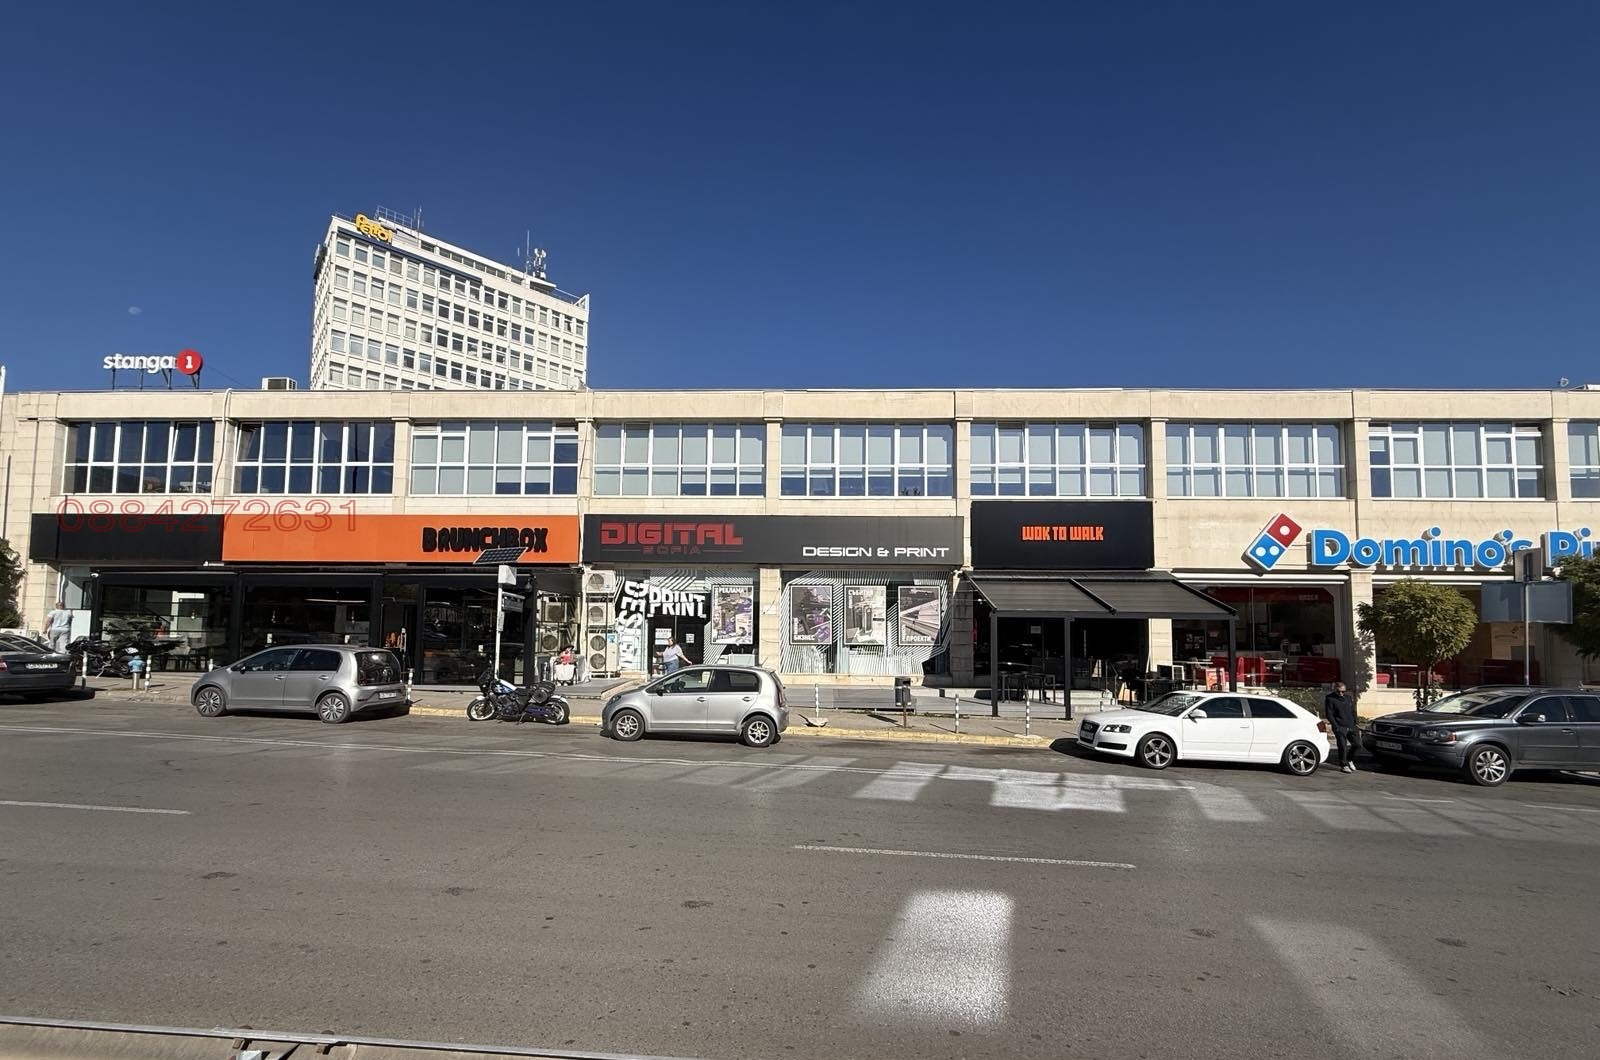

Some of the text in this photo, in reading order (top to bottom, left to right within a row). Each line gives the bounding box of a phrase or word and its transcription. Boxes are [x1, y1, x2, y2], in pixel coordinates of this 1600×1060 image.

[103, 353, 175, 373] stanga
[422, 527, 548, 552] BRUNCHBOX
[600, 521, 744, 545] DIGITAL
[1022, 525, 1104, 541] WOK TO WALK
[802, 546, 950, 558] DESIGN & PRINT
